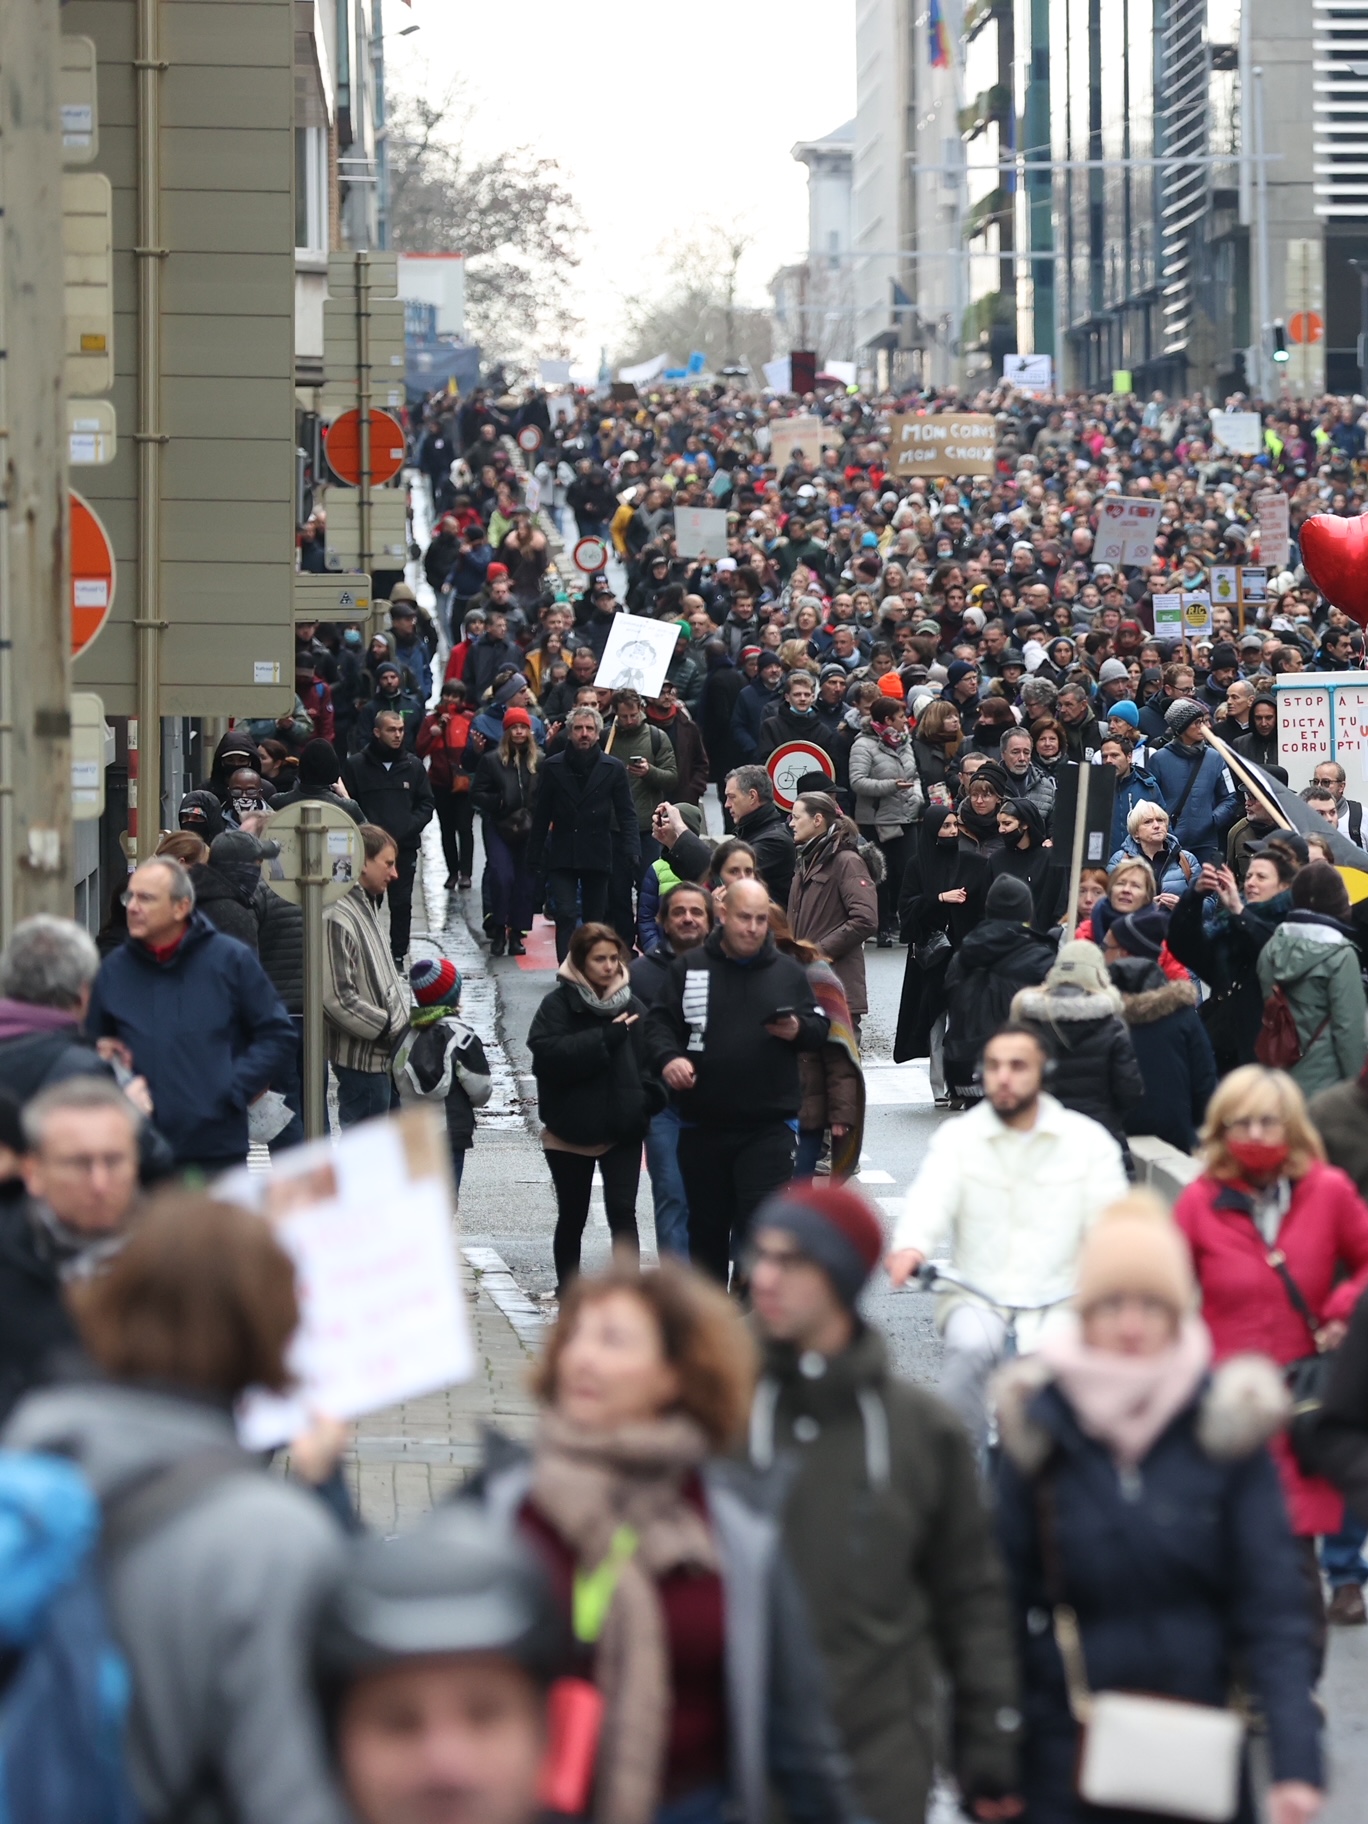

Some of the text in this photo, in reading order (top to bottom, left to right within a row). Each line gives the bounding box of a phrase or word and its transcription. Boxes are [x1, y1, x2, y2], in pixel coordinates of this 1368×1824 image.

[902, 424, 947, 442] MON
[899, 448, 937, 464] MON
[1284, 697, 1324, 707] STOP
[1301, 731, 1318, 739] ET
